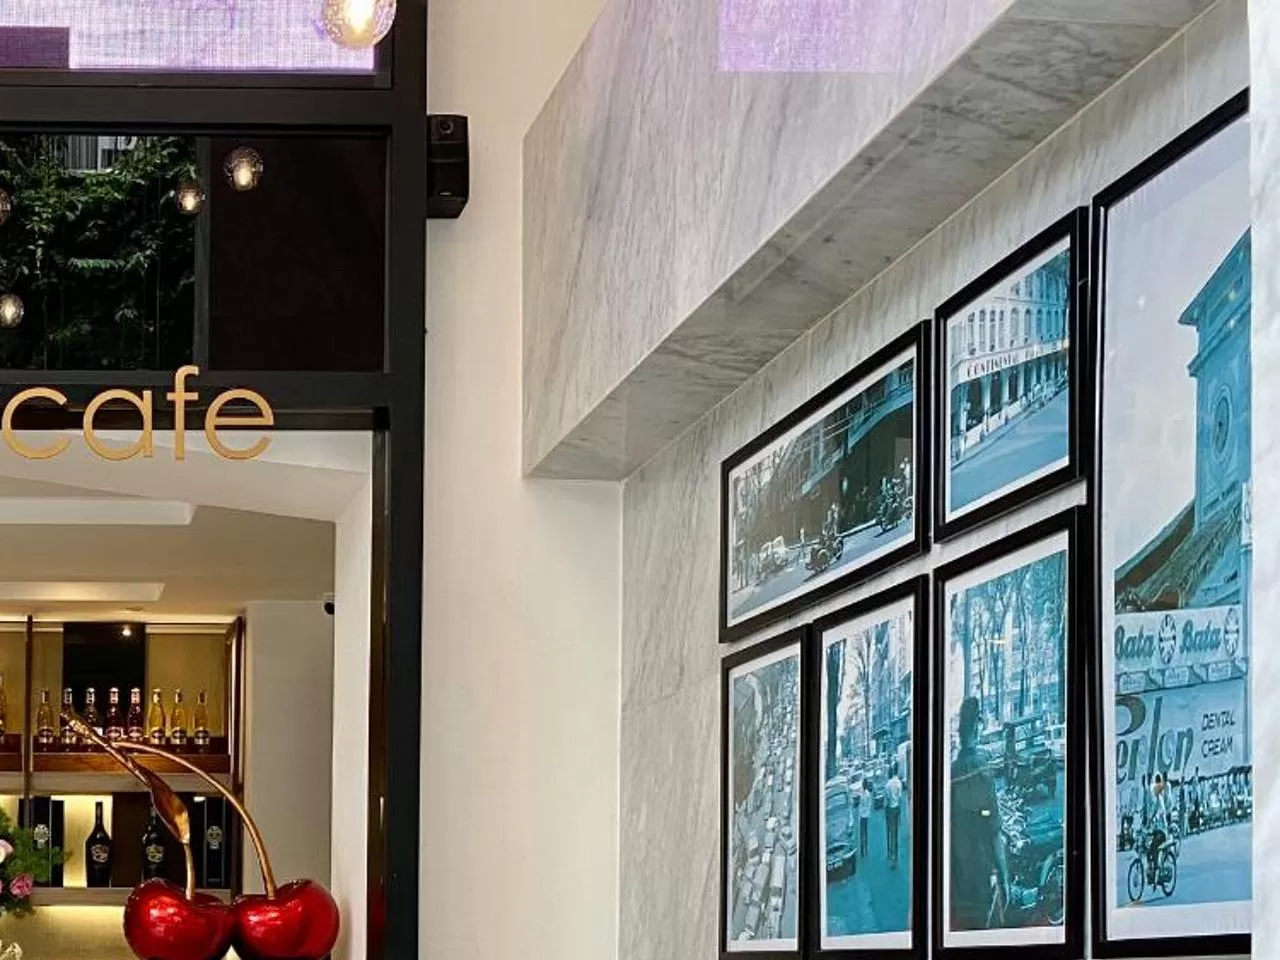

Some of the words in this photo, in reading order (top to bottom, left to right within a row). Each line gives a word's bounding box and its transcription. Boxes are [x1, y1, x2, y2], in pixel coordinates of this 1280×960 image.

[1, 364, 274, 461] cafe
[1201, 710, 1235, 731] DENTAL
[1201, 736, 1233, 758] CREAM
